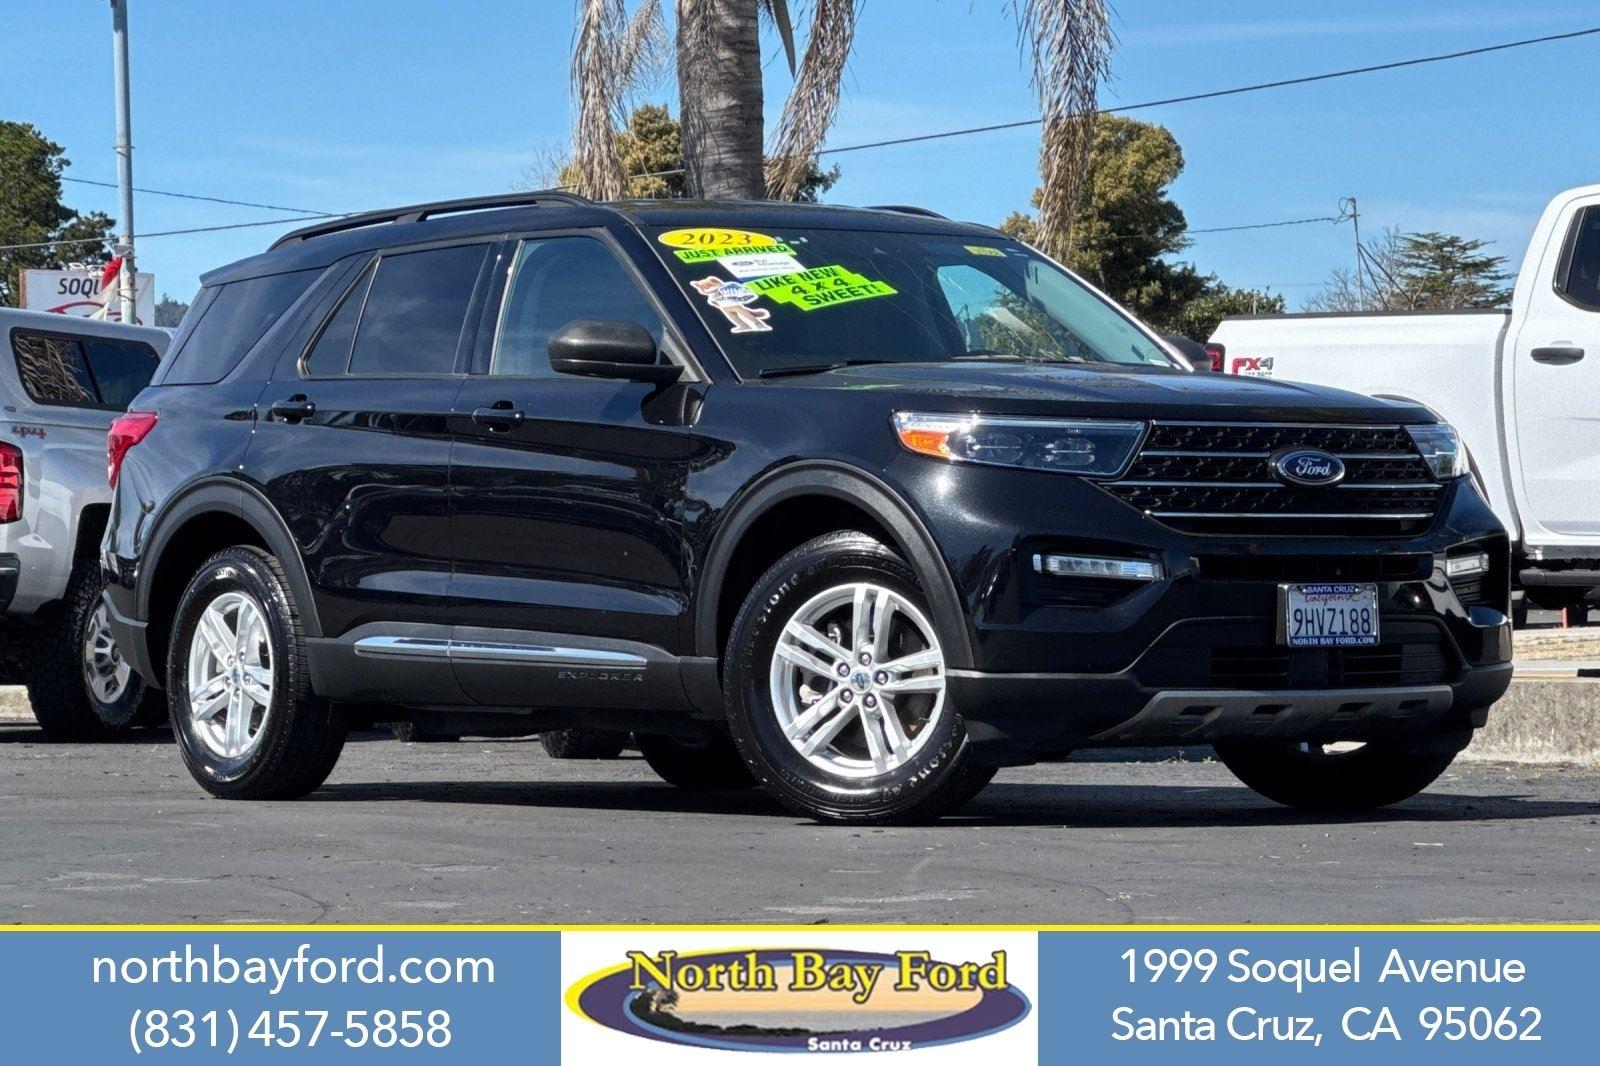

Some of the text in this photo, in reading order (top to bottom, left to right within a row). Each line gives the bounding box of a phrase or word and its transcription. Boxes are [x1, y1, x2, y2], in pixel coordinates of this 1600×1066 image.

[682, 232, 752, 246] 2023
[683, 244, 789, 260] JUST ARRIVED
[754, 274, 796, 291] LIKE
[797, 266, 838, 281] NEW
[803, 283, 885, 306] SWEET!
[1232, 357, 1274, 375] FX4
[1296, 457, 1331, 476] Ford
[1307, 585, 1355, 593] SANTA CRUZ
[1293, 607, 1371, 636] 9HVZ188
[1292, 637, 1375, 646] NORTH BAY FORD.COM
[557, 671, 644, 682] EXPLORER
